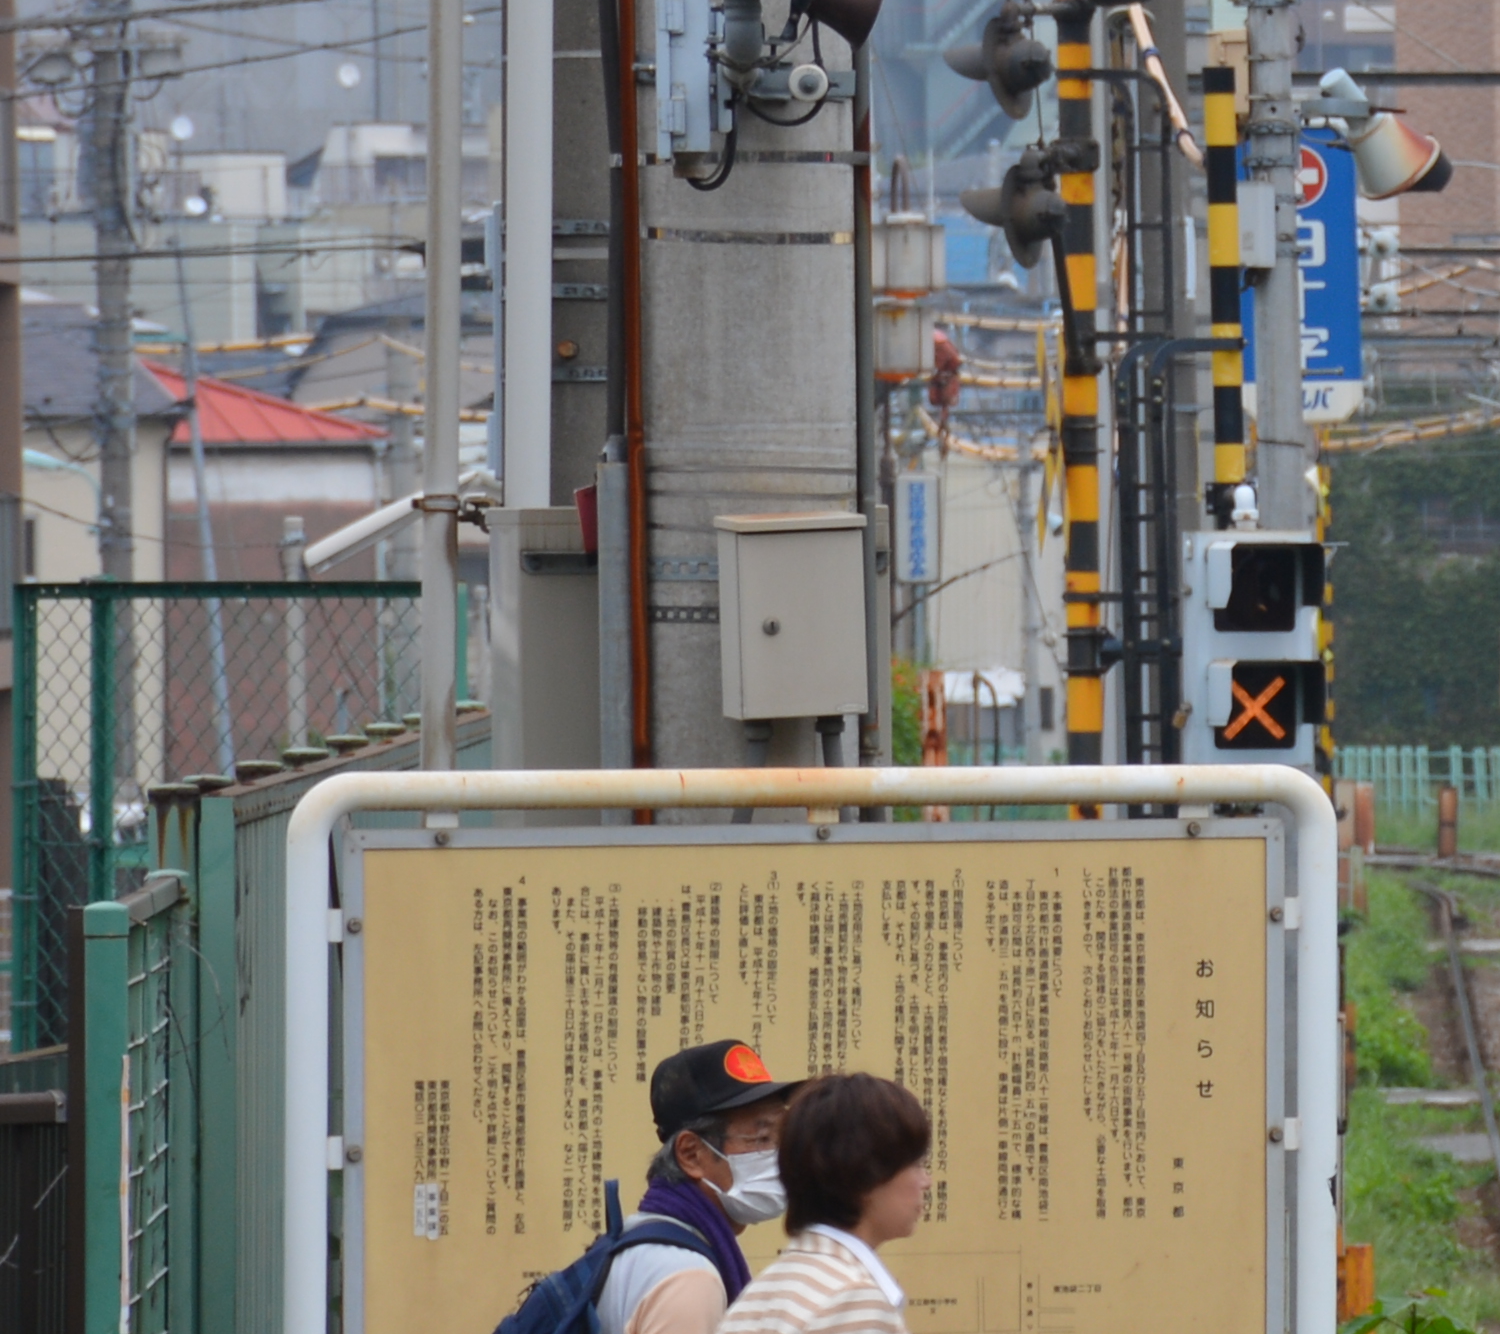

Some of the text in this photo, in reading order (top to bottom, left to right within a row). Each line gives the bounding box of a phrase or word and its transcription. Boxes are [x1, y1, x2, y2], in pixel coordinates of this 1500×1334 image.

[1196, 959, 1215, 1098] お知らせ
[1172, 1157, 1185, 1218] 東京都
